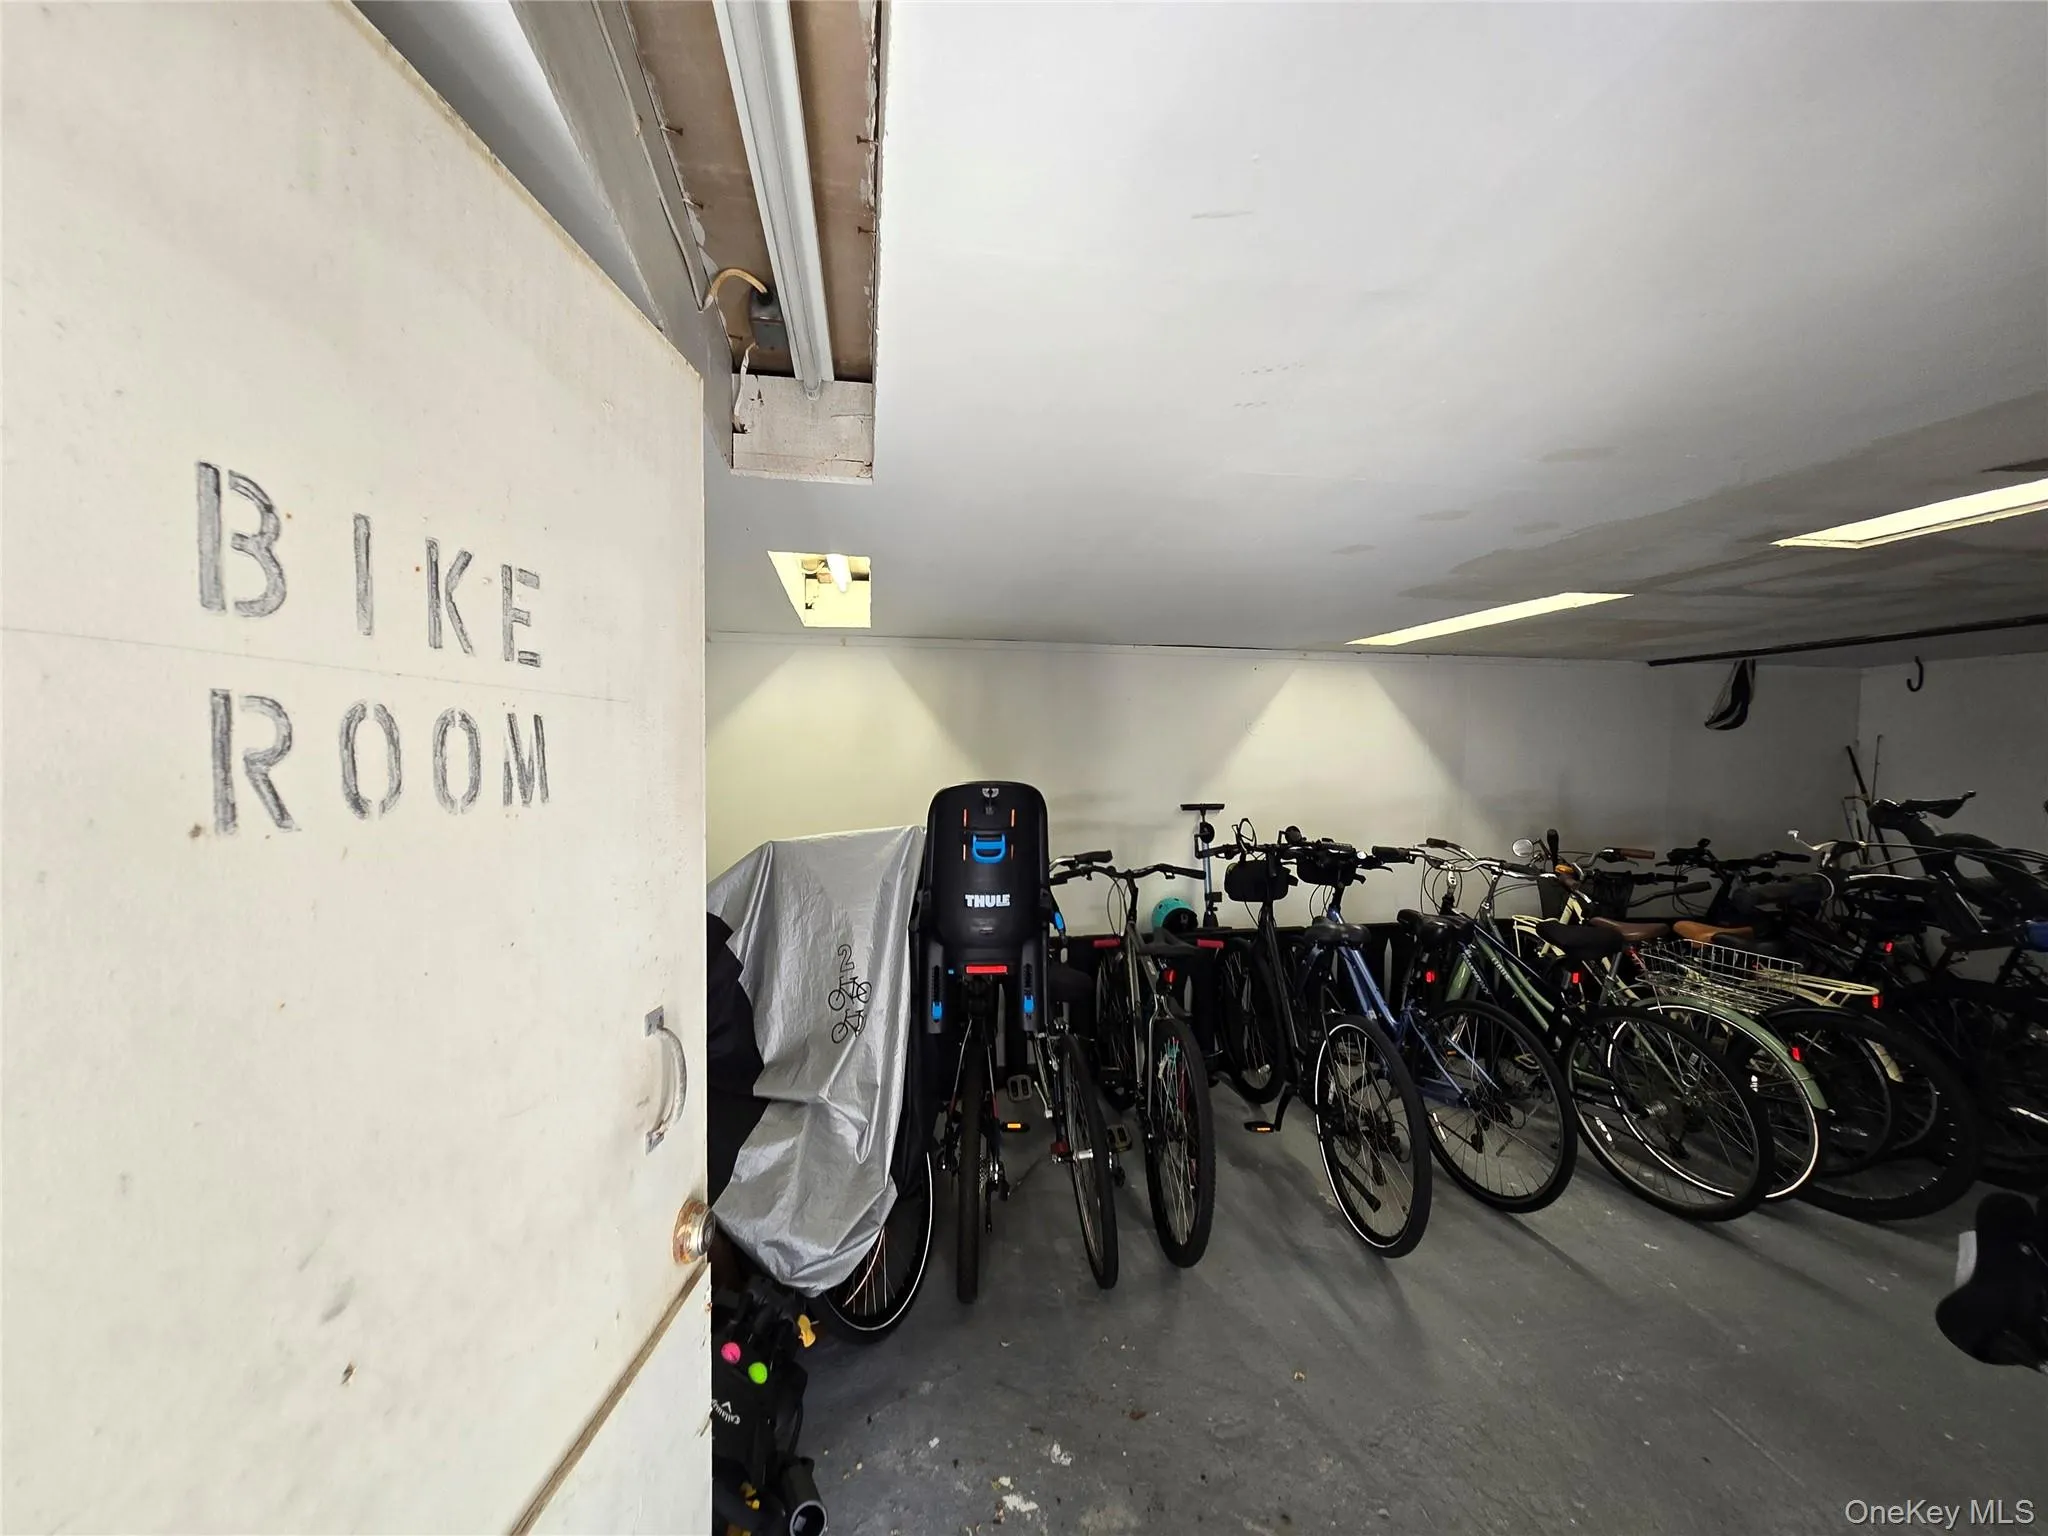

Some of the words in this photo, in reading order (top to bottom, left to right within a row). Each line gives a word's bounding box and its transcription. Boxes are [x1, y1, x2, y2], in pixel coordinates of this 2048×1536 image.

[196, 461, 542, 668] BIKE
[209, 688, 550, 836] ROOM
[964, 894, 1011, 908] THULE
[837, 943, 855, 973] 2
